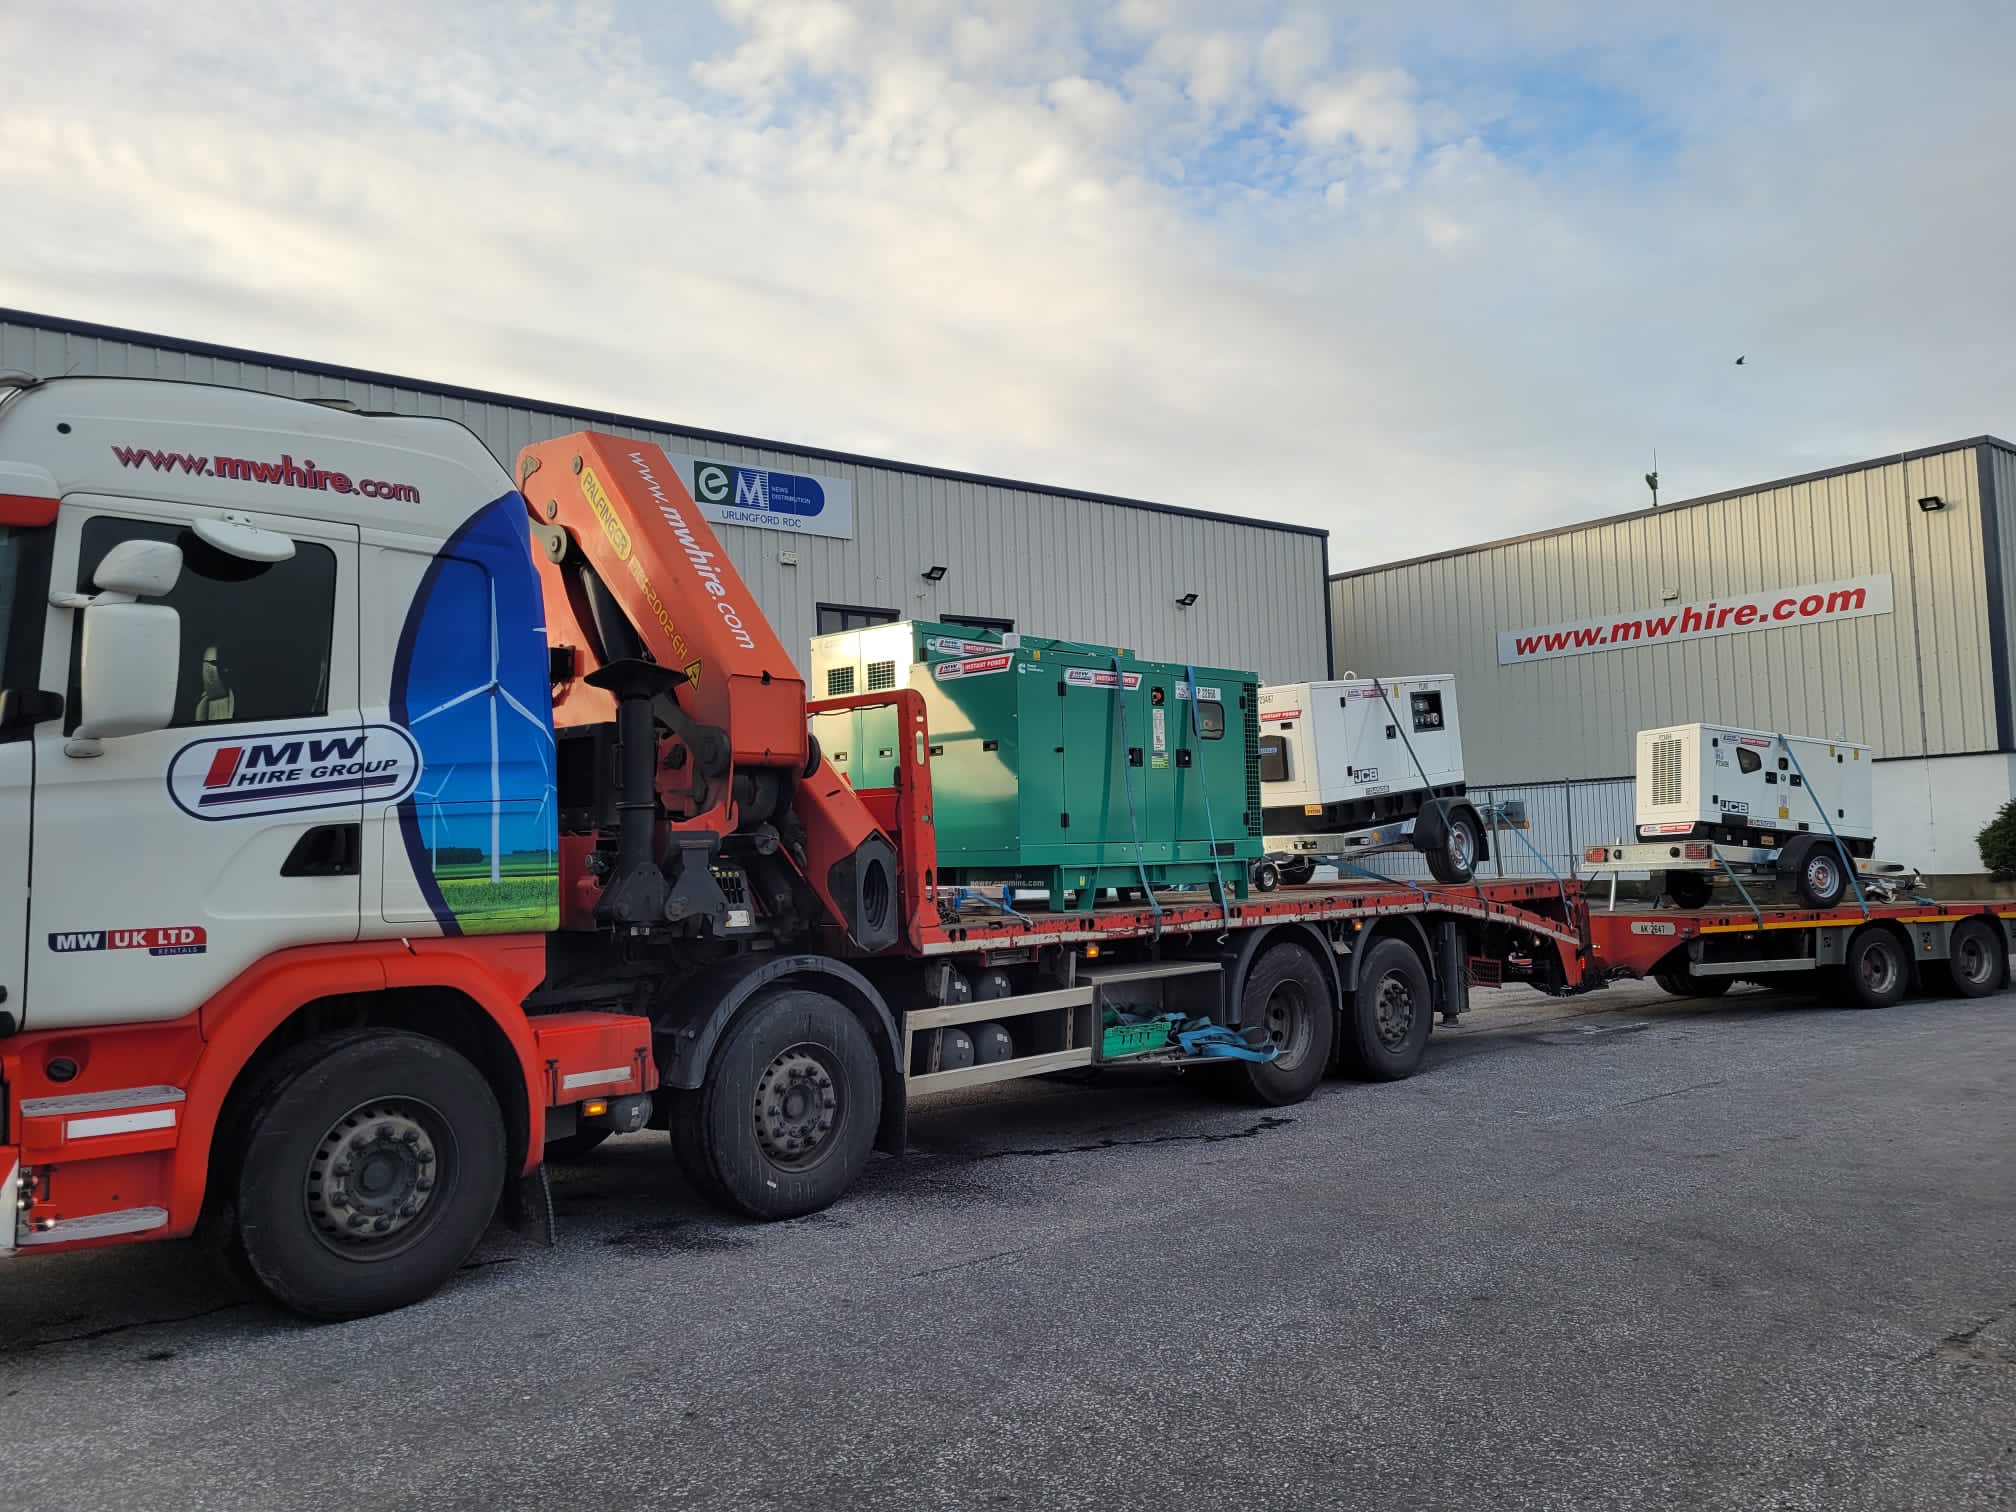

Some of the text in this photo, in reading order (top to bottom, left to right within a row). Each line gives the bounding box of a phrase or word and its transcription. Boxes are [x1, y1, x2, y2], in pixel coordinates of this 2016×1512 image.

[111, 445, 420, 503] www.mwhire.com
[771, 486, 789, 494] NEWS
[771, 494, 811, 504] DISTRIBUTION
[583, 472, 629, 556] PALFINGER
[722, 510, 802, 528] URLINGFORD RDC
[627, 452, 755, 649] www.mwhire.com
[1515, 587, 1866, 656] www.mwhire.com
[237, 759, 398, 786] HIRE GROUP
[1354, 769, 1378, 783] JCB
[1720, 801, 1748, 813] JCB
[56, 929, 195, 950] MW UK LTD
[158, 946, 198, 955] RENTALS
